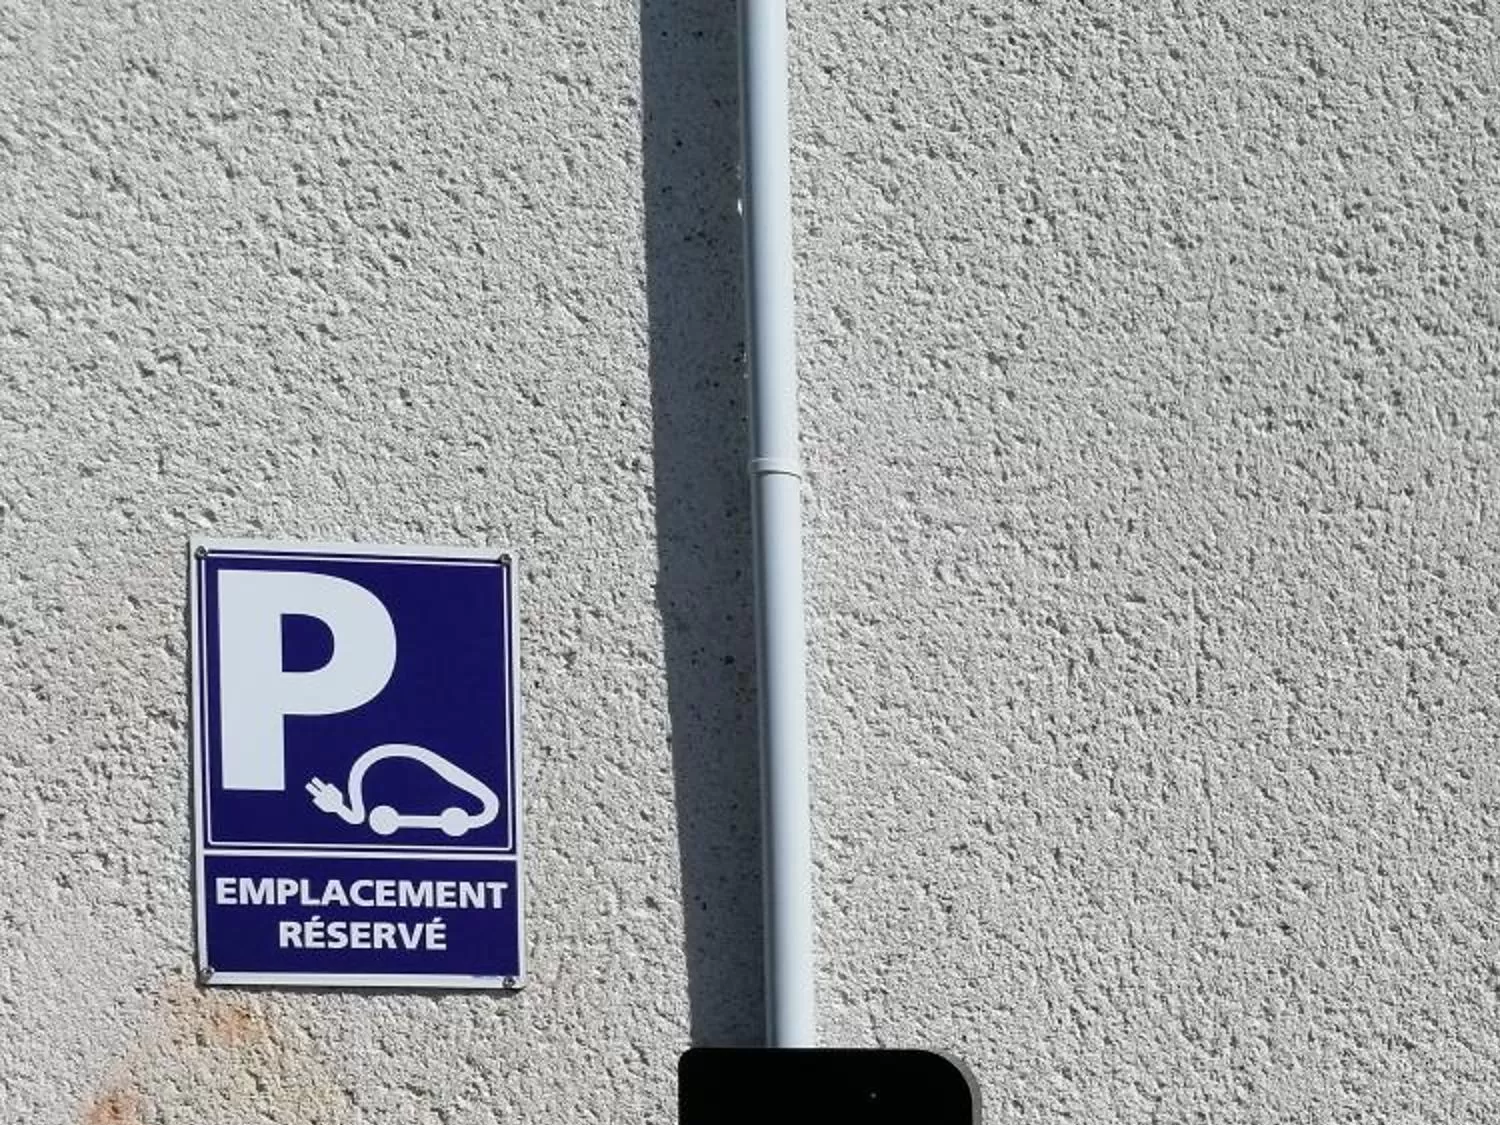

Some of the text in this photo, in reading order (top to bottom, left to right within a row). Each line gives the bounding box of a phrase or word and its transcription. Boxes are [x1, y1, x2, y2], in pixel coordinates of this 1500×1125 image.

[218, 569, 397, 790] P
[216, 877, 508, 909] EMPLACEMENT
[279, 915, 447, 951] RÉSERVÉ
